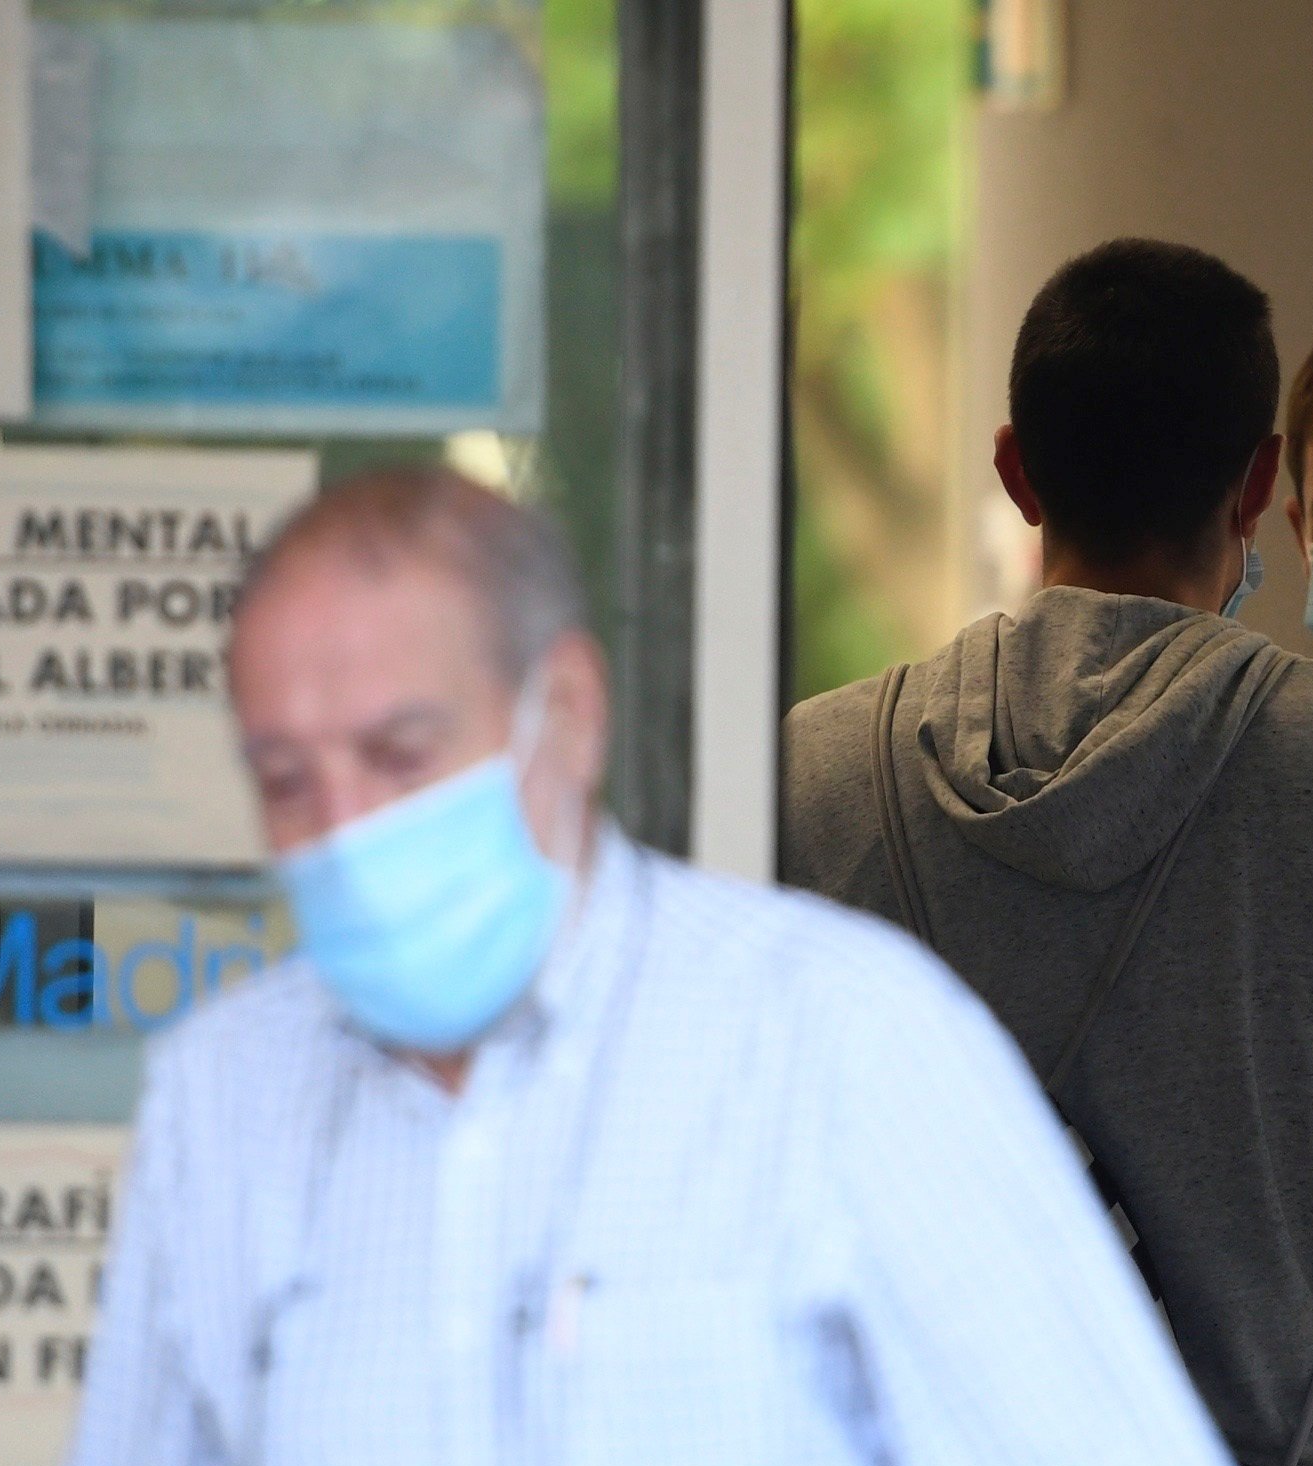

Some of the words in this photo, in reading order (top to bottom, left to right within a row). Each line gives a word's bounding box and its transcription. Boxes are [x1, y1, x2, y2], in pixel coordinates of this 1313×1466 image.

[14, 506, 254, 556] MENTAL
[115, 580, 243, 626] POR
[30, 646, 228, 695] ALBER
